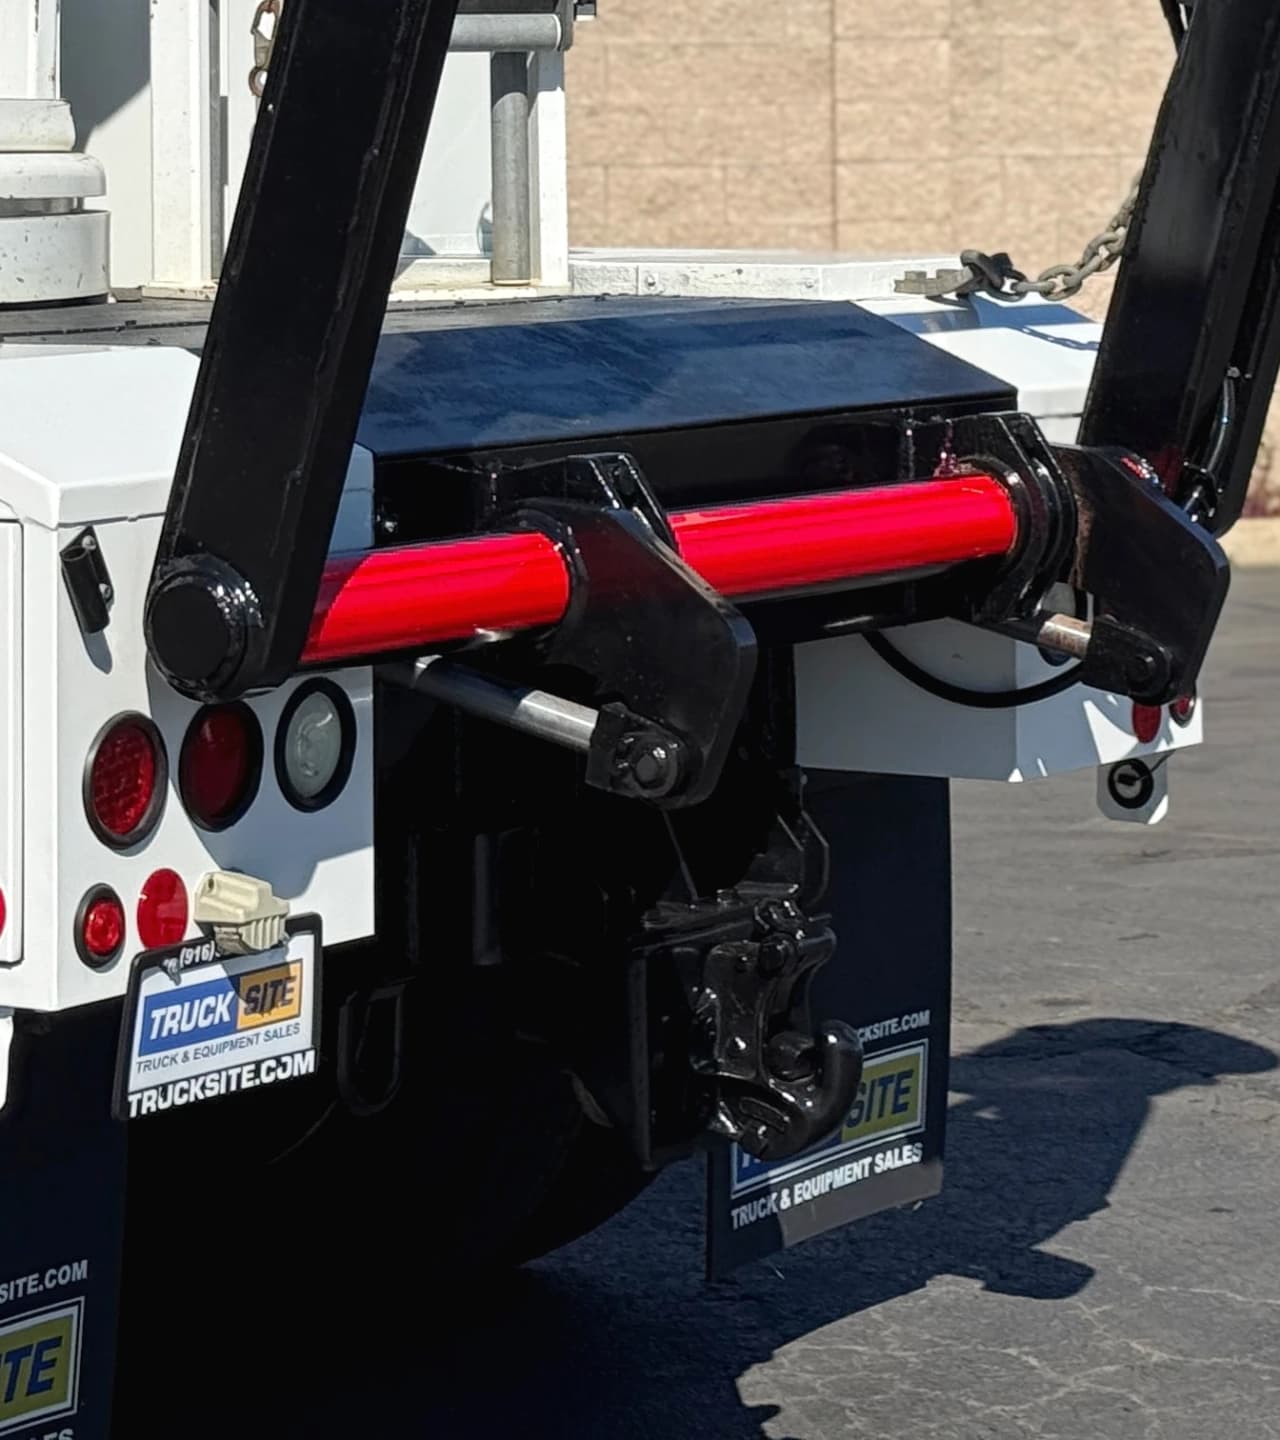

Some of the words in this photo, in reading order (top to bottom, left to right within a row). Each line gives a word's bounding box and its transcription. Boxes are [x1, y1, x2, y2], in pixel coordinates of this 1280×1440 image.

[149, 991, 235, 1041] TRUCK
[243, 975, 297, 1016] SITE
[856, 1010, 931, 1044] CKSITE.COM
[136, 1054, 180, 1074] TRUCK
[181, 1048, 192, 1064] &
[193, 1034, 261, 1061] EQUIPMENT
[263, 1022, 301, 1042] SALES
[128, 1049, 316, 1118] TRUCKSITE.COM
[730, 1193, 778, 1231] TRUCK
[779, 1188, 792, 1210] &
[793, 1157, 873, 1206] EQUIPMENT
[873, 1143, 924, 1174] SALES
